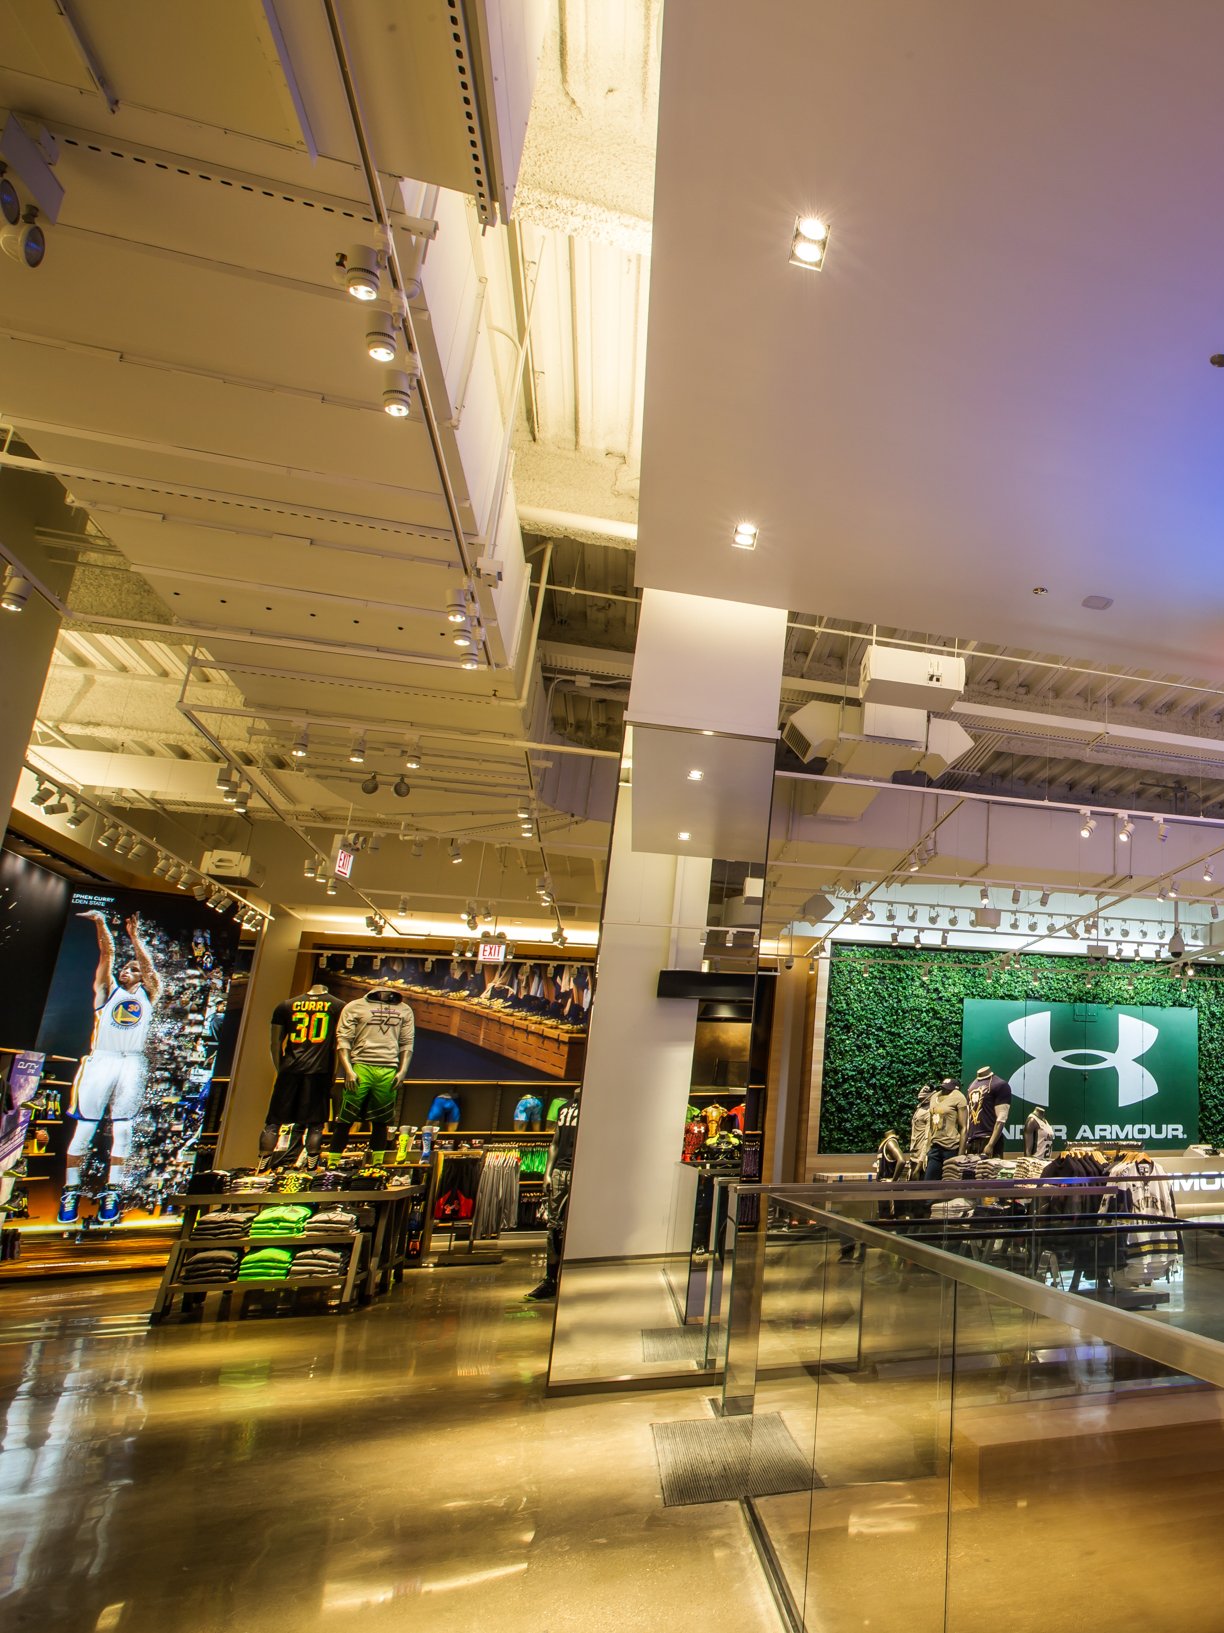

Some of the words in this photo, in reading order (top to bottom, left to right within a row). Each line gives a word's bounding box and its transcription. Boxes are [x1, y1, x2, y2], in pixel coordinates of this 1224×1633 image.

[338, 851, 352, 872] EXIT
[72, 893, 93, 901] EPHEN
[94, 895, 115, 903] CURRY
[482, 944, 502, 957] EXIT
[127, 1003, 140, 1013] 30
[292, 1001, 332, 1012] CURRY
[289, 1011, 330, 1044] 30
